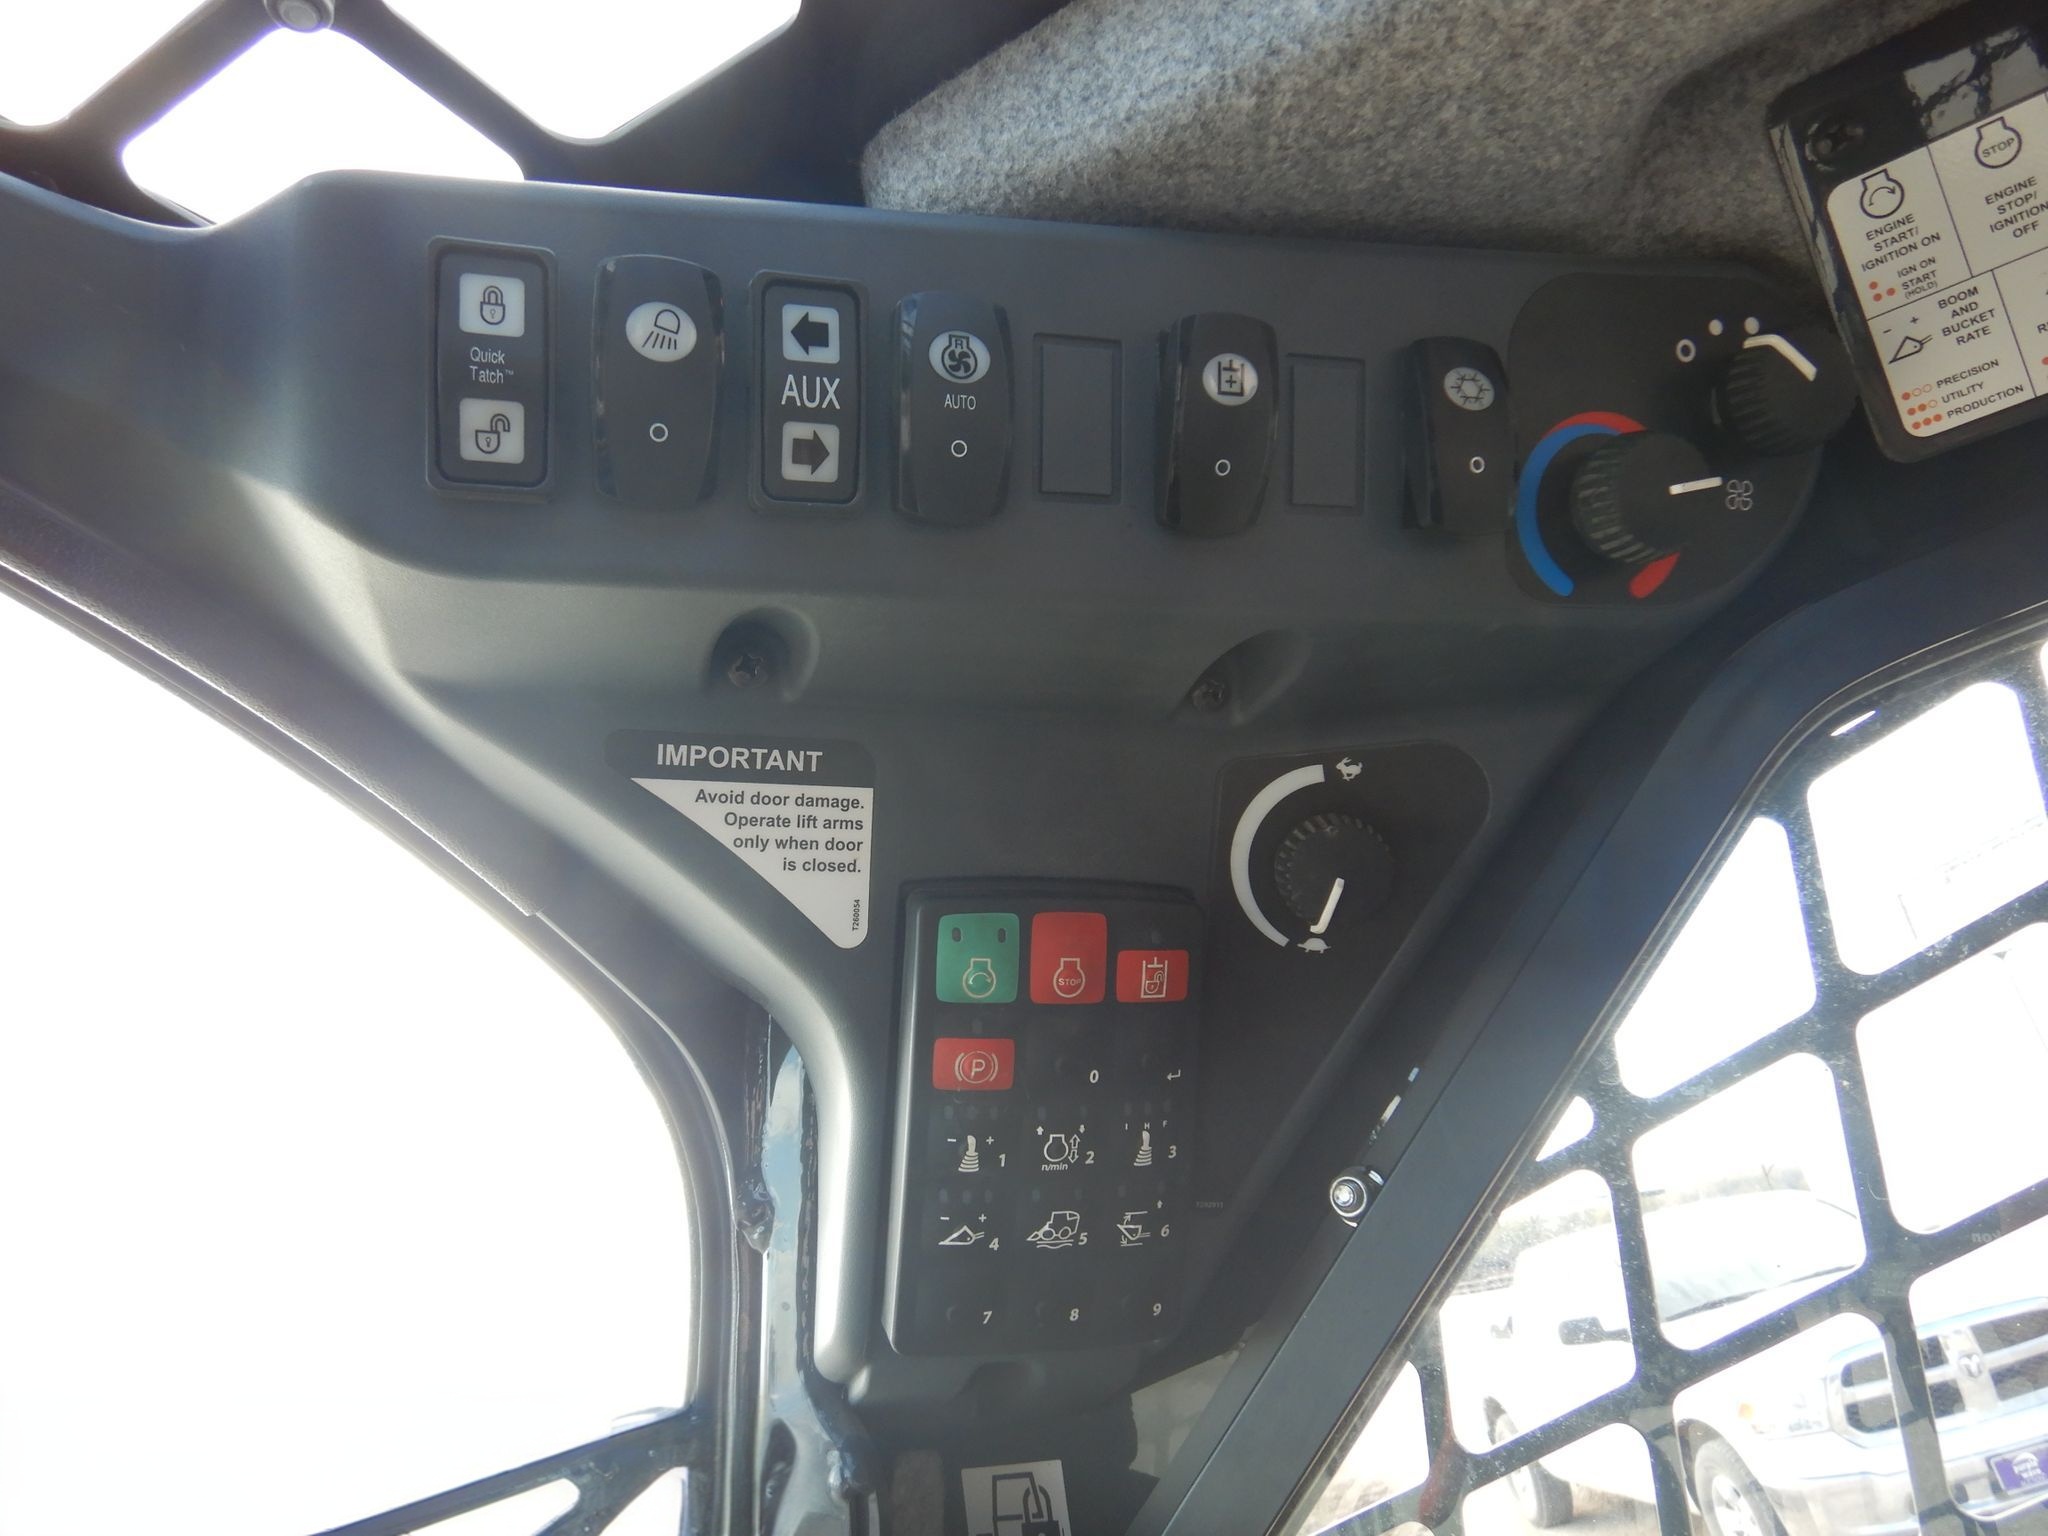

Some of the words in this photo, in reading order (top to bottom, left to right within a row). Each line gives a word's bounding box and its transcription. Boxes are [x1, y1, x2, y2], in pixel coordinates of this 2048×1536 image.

[1982, 137, 2015, 158] STOP
[1984, 176, 2038, 205] ENGINE
[1997, 191, 2037, 215] STOP/
[1990, 201, 2048, 233] IGNITION
[1866, 213, 1915, 241] ENGINE
[2013, 220, 2039, 238] OFF
[1873, 226, 1919, 252] START/
[1861, 242, 1918, 272] IGNITION
[1921, 232, 1941, 247] ON
[1897, 264, 1917, 278] IGN
[1919, 256, 1936, 269] ON
[1901, 270, 1937, 290] START
[1904, 280, 1938, 300] (HOLD)
[1938, 286, 1979, 309] BOOM
[1951, 301, 1979, 319] AND
[1942, 308, 1996, 337] BUCKET
[1956, 325, 1991, 346] RATE
[470, 346, 505, 365] Quick
[1936, 359, 1999, 389] PRECISION
[781, 374, 841, 410] AUX
[944, 393, 976, 410] AUTO
[1941, 381, 1984, 404] UTILITY
[1947, 384, 2024, 419] PRODUCTION
[656, 743, 823, 772] IMPORTANT
[695, 789, 745, 804] Avoid
[750, 791, 790, 806] door
[795, 793, 865, 812] damage.
[724, 812, 791, 829] Operate
[796, 814, 818, 829] lift
[822, 817, 864, 830] arms
[733, 835, 769, 852] only
[775, 836, 819, 850] when
[825, 837, 863, 851] door
[782, 858, 796, 871] is
[802, 858, 861, 873] closed.
[1058, 977, 1082, 986] STOP
[971, 1059, 986, 1078] P
[1089, 1070, 1099, 1083] 0
[999, 1154, 1007, 1167] 1
[1085, 1151, 1095, 1165] 2
[1168, 1146, 1177, 1158] 3
[1041, 1162, 1069, 1171] n/min
[1078, 1232, 1088, 1245] 5
[1160, 1224, 1170, 1237] 6
[989, 1238, 999, 1250] 4
[983, 1311, 993, 1324] 7
[1069, 1308, 1079, 1321] 8
[1152, 1303, 1162, 1316] 9
